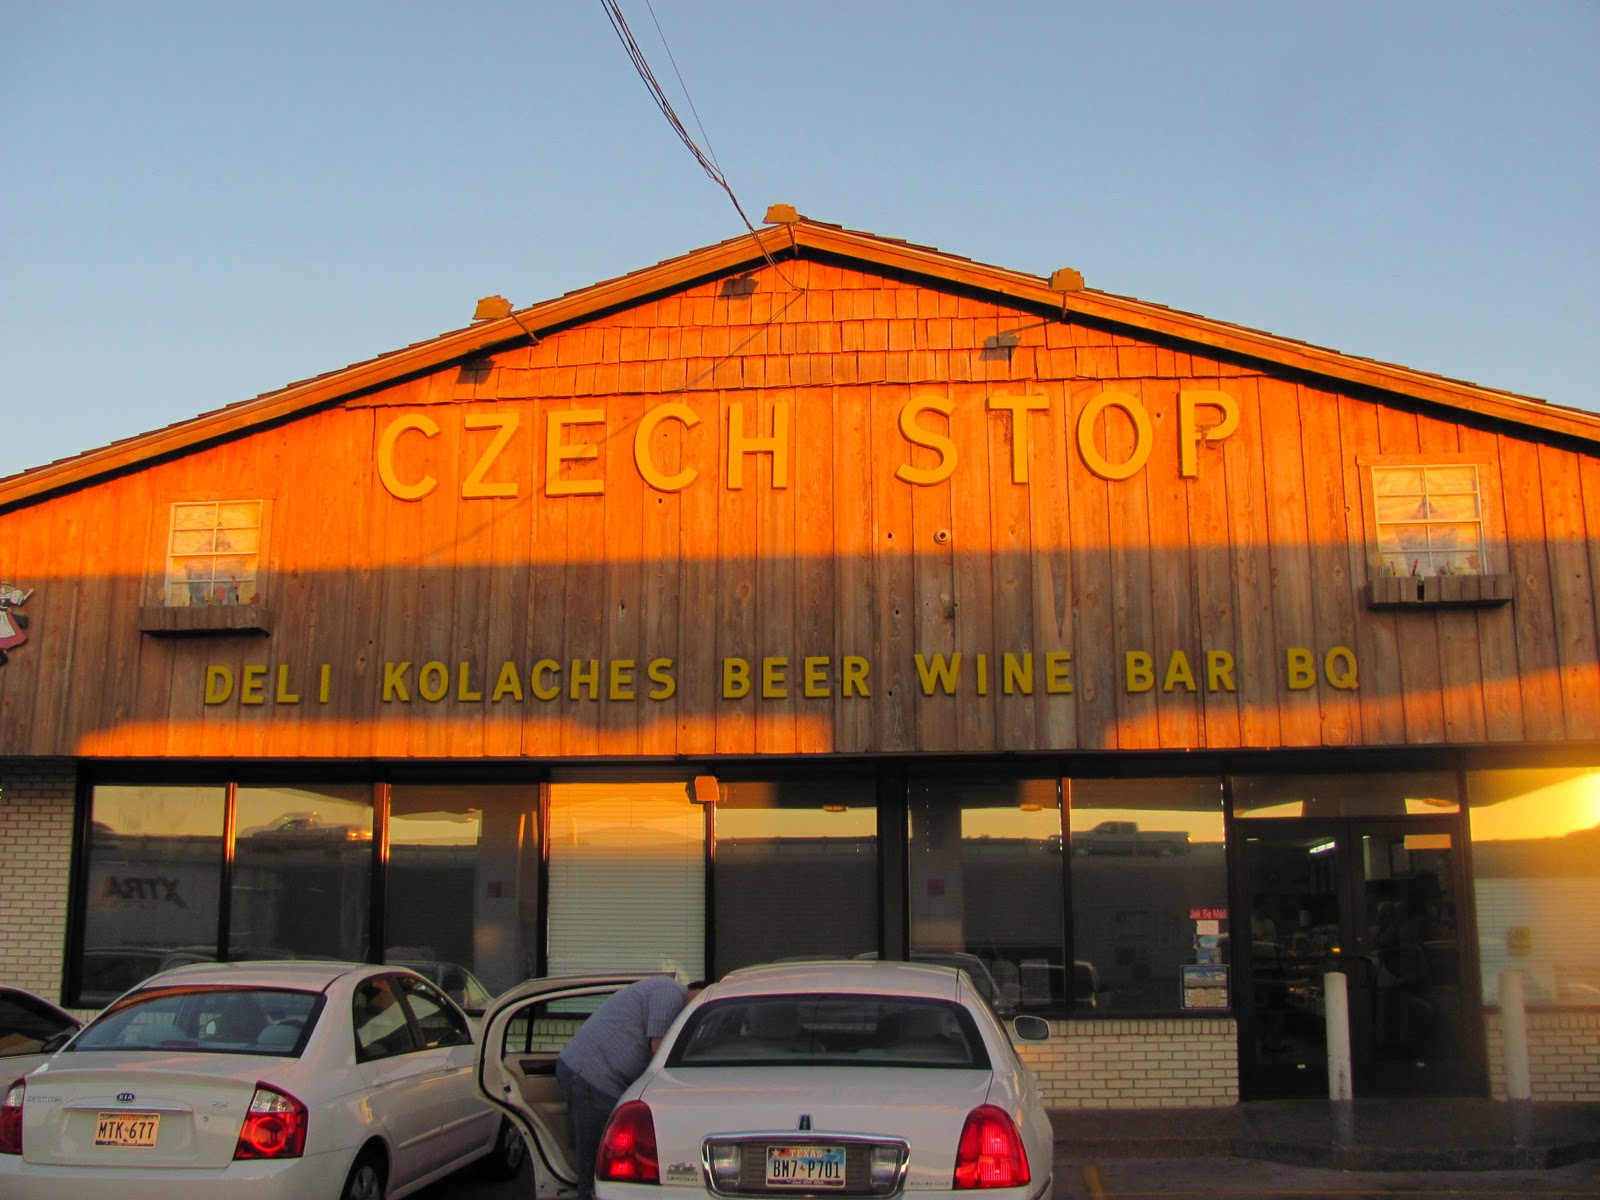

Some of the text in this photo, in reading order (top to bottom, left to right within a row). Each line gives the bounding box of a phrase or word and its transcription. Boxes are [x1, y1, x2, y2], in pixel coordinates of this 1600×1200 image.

[377, 390, 1241, 501] CZECH STOP
[204, 646, 1359, 704] DELI KOLACHES BEER WINE BAR BQ
[1202, 909, 1212, 919] Se
[789, 1149, 823, 1158] TEXAS
